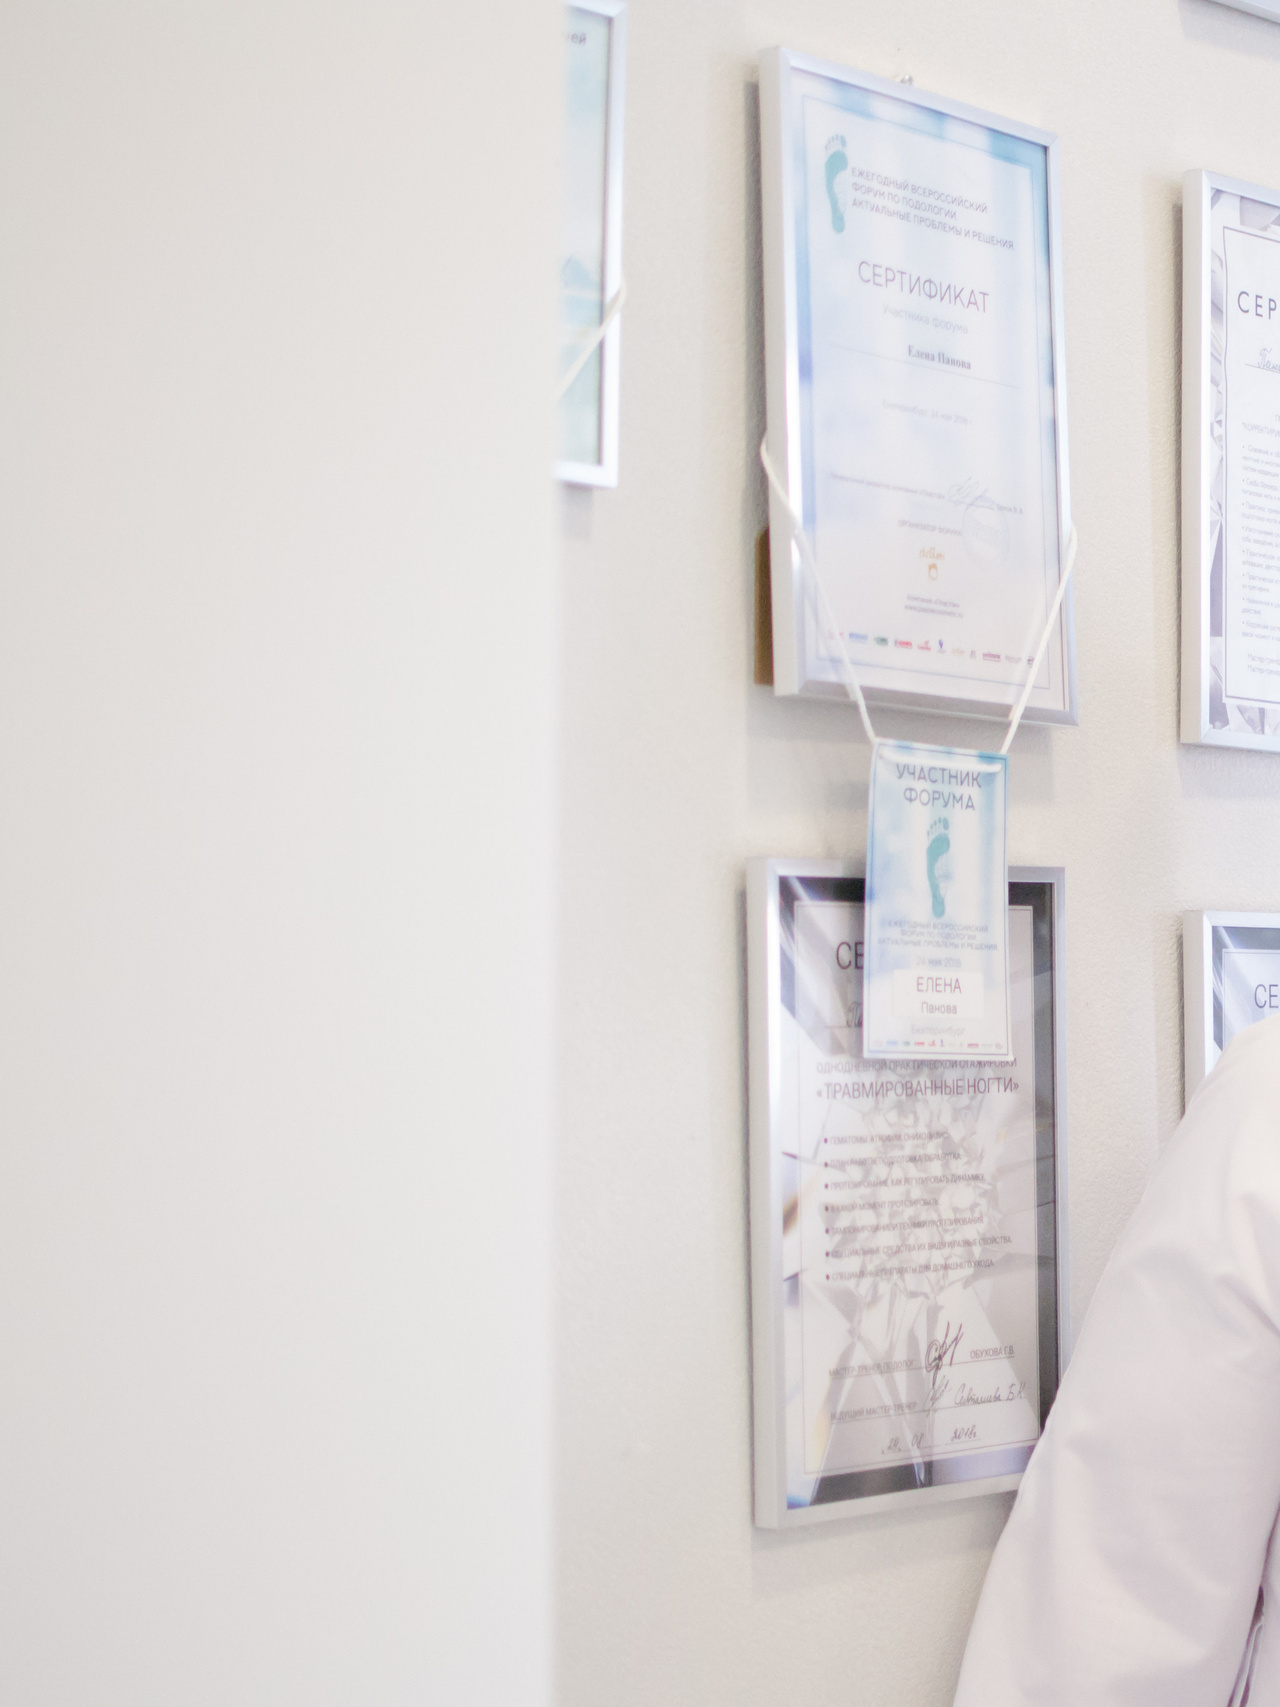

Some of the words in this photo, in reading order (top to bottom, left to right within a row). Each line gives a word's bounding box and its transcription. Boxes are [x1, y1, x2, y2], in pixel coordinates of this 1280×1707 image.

[851, 167, 909, 190] ЕЖЕГОДНЫЙ
[911, 185, 988, 214] ВСЕРОССИЙСКИЙ
[851, 182, 885, 199] ФОРУМ
[887, 192, 899, 203] ПО
[852, 198, 911, 222] АКТУАЛЬНЫЕ
[913, 214, 962, 236] ПРОБЛЕМЫ
[964, 226, 970, 238] И
[858, 261, 990, 313] СЕРТИФИКАТ
[908, 345, 935, 362] Елена
[938, 352, 971, 370] Панова
[896, 763, 982, 789] УЧАСТНИК
[903, 787, 975, 811] ФОРУМА
[916, 976, 962, 994] ЕЛЕНА
[921, 1001, 958, 1015] Панова
[816, 1078, 964, 1100] «ТРАВМИРОВАННЫЕ
[966, 1077, 1020, 1095] НОГТИ»
[970, 1347, 1004, 1359] ОБУХОВА
